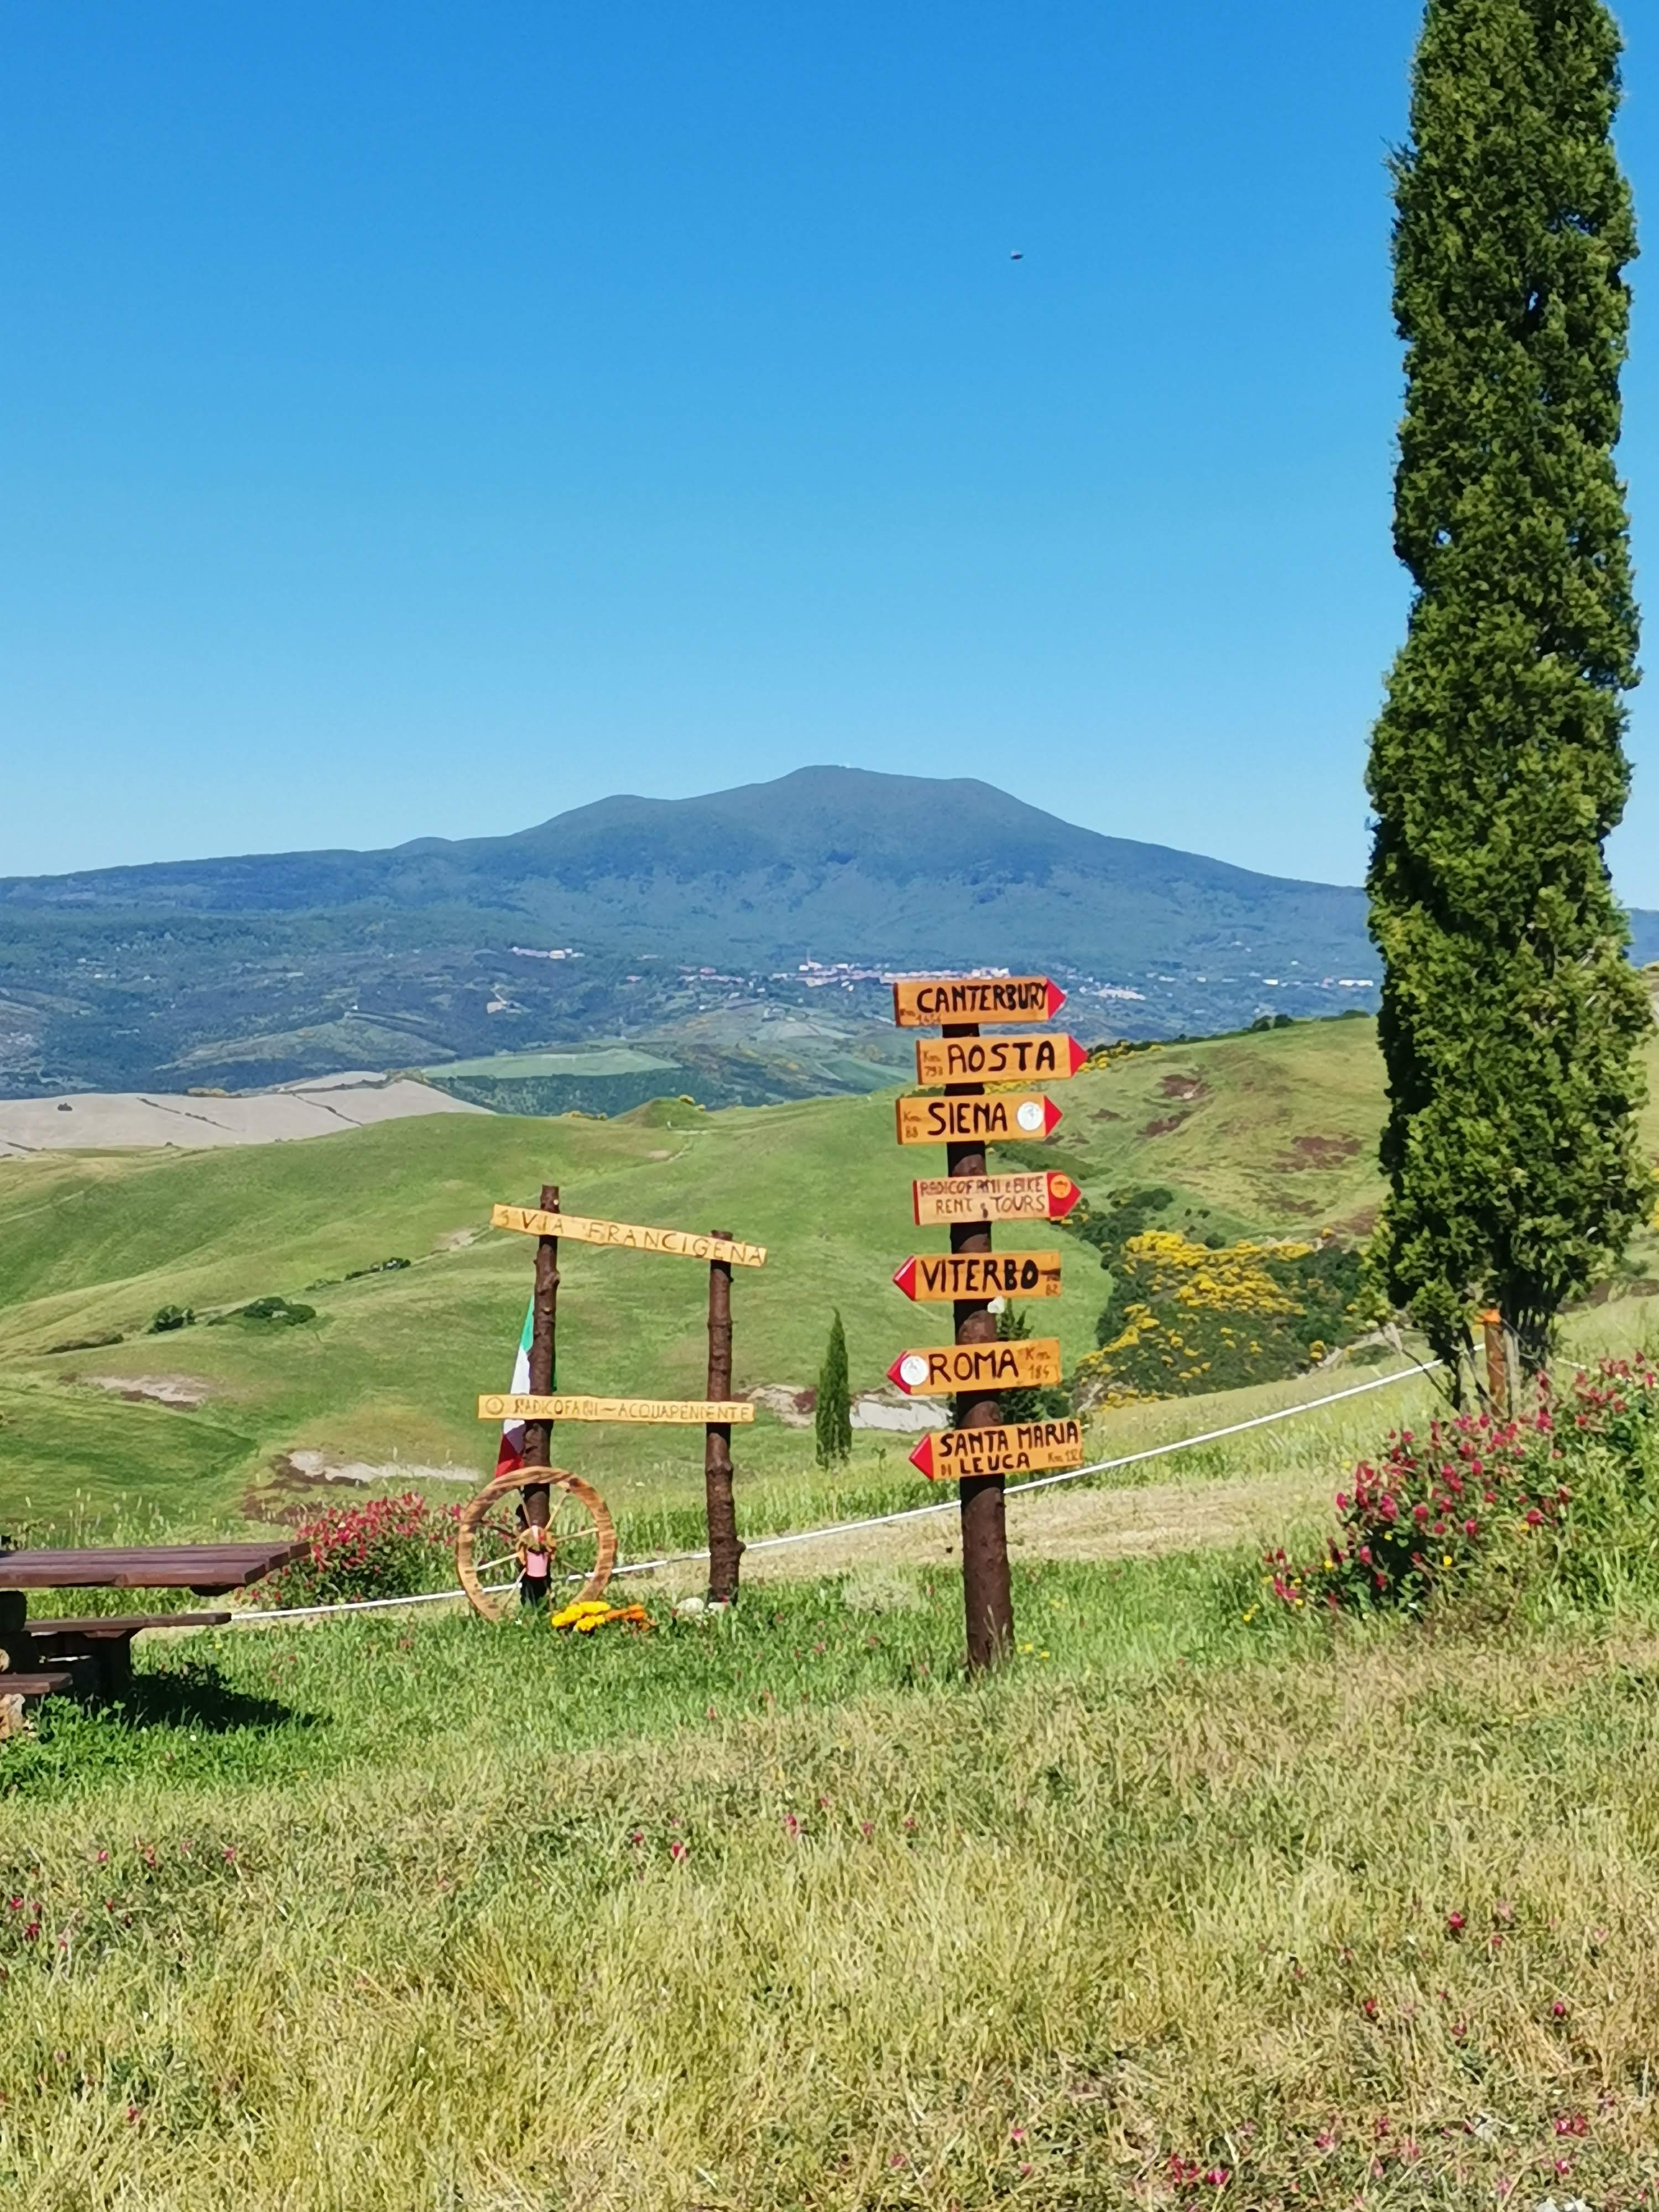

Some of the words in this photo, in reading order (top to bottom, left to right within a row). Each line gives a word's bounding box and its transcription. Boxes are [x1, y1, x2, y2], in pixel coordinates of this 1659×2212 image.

[917, 982, 1047, 1013] CANTERBURY
[947, 1040, 1055, 1075] AOSTA
[902, 1110, 922, 1122] Km
[927, 1102, 1008, 1135] SIENA
[936, 1197, 973, 1215] RENT
[989, 1194, 1046, 1213] TOURS
[521, 1210, 564, 1234] VIA
[587, 1222, 764, 1265] FRANCIGENA
[920, 1259, 1039, 1292] VITERBO
[928, 1348, 1019, 1386] ROMA
[1025, 1346, 1051, 1361] Km
[938, 1430, 1009, 1457] SANTA
[1017, 1421, 1079, 1451] MARIA
[941, 1464, 952, 1477] DI
[959, 1452, 1031, 1475] LEUCA
